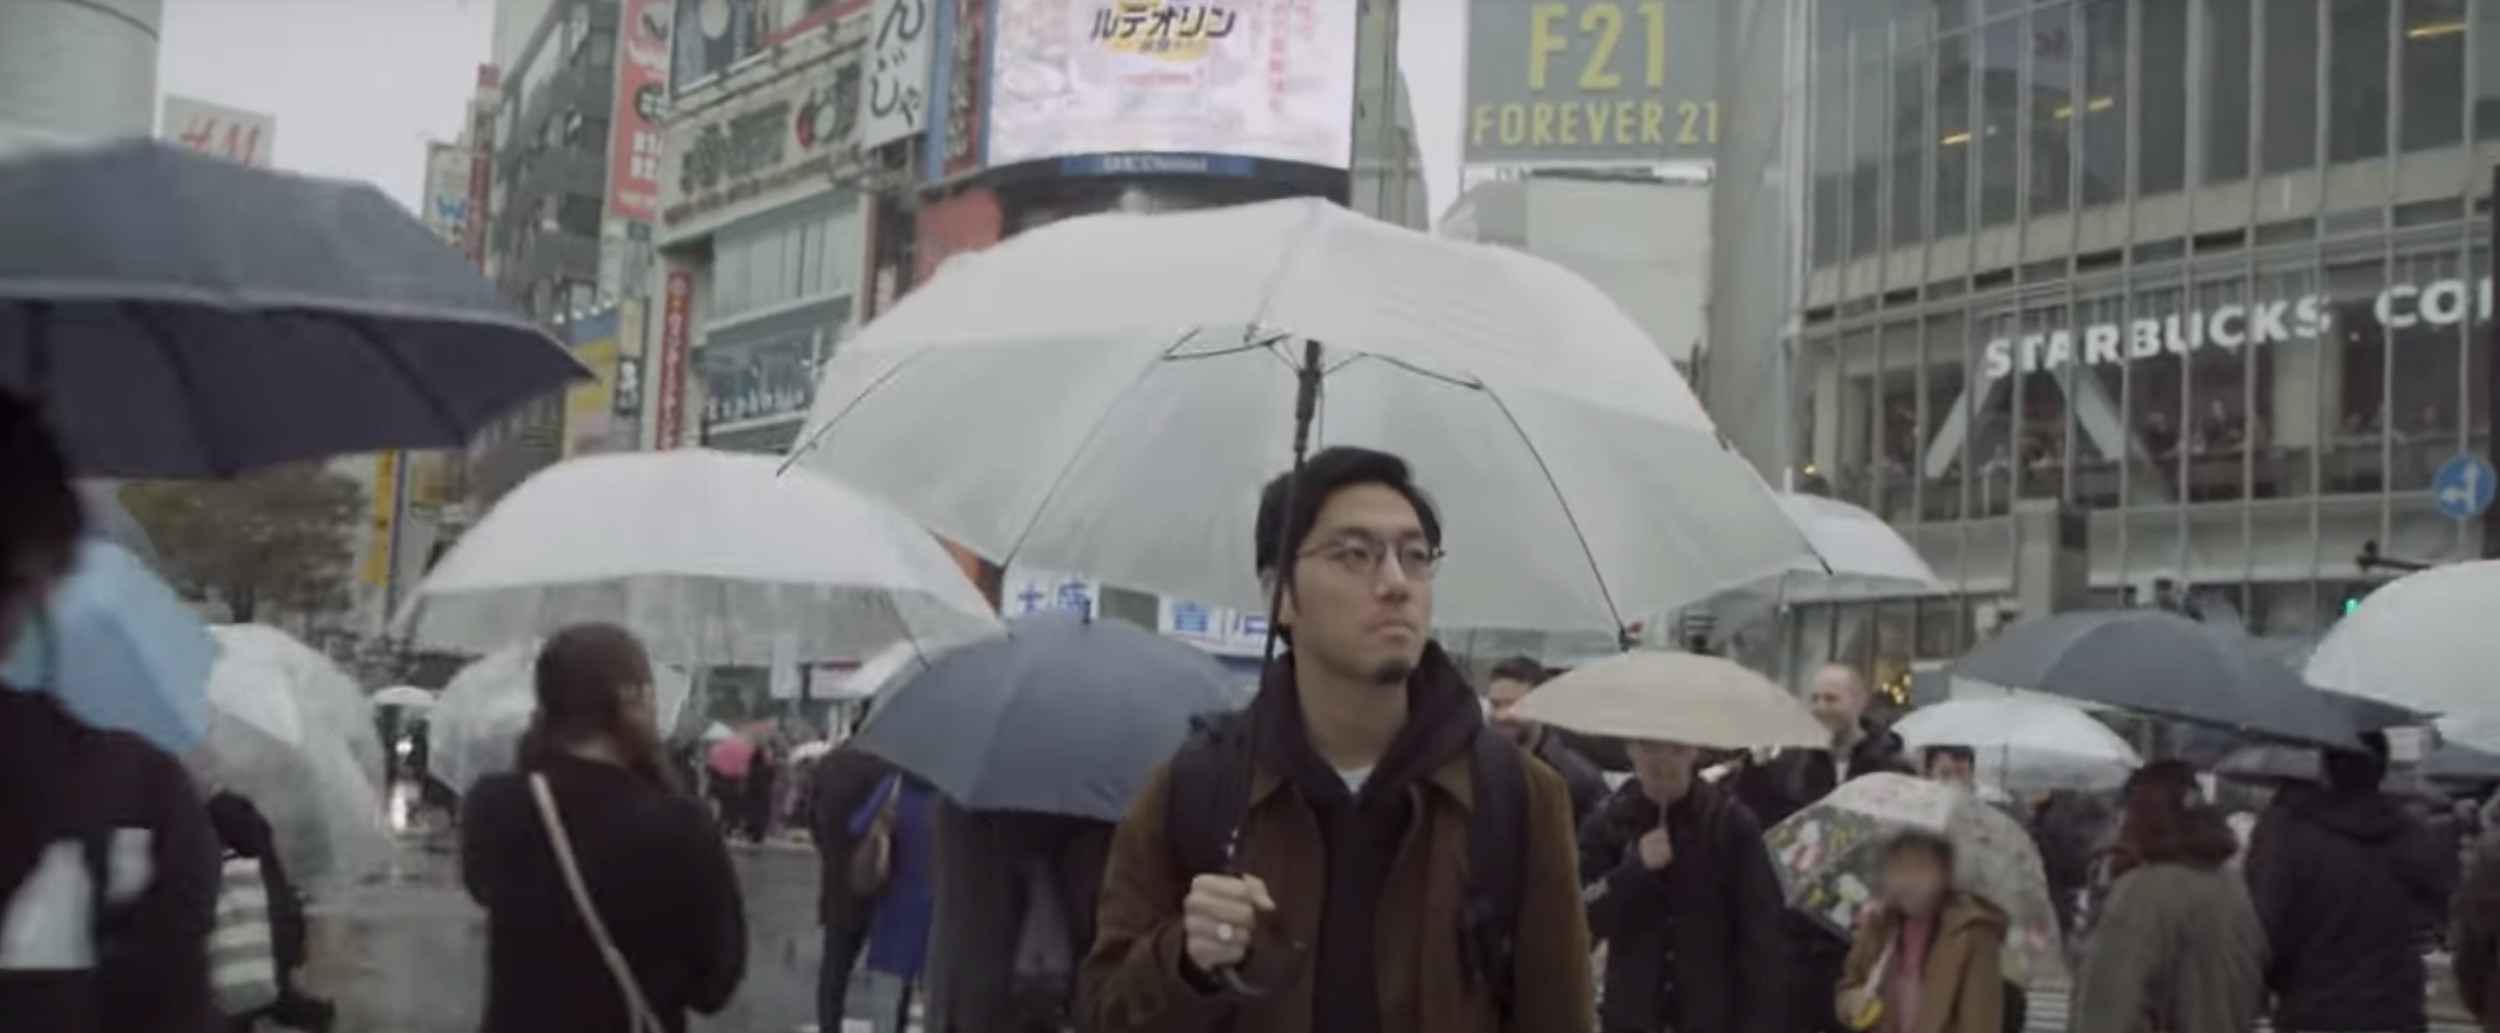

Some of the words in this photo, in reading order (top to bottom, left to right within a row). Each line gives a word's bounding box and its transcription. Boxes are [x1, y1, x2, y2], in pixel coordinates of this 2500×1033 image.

[1090, 5, 1236, 40] ルテオリン
[1529, 2, 1666, 91] F21
[1473, 101, 1664, 146] FOREVER
[1676, 100, 1721, 145] 21
[1984, 293, 2331, 379] STARBUCKS
